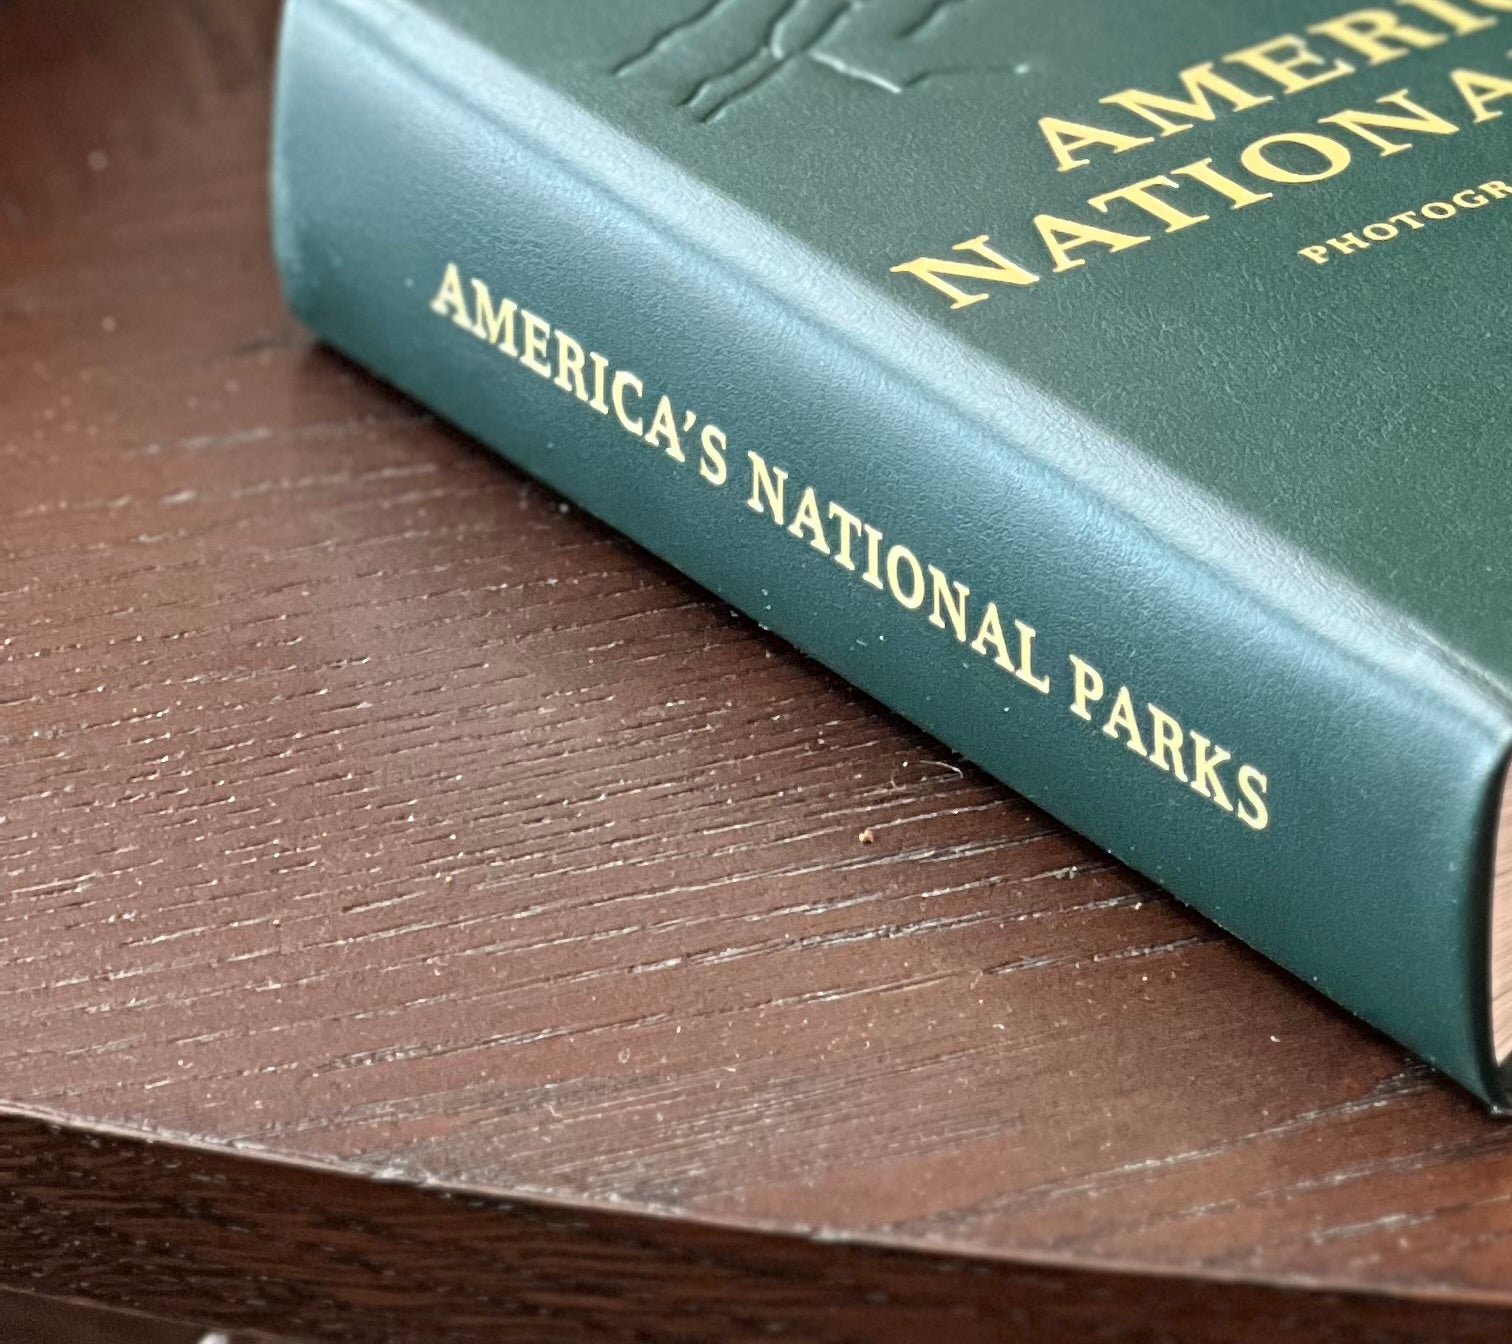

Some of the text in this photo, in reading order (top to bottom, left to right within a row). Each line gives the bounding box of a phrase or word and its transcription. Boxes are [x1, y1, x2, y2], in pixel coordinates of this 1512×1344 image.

[429, 261, 1271, 832] AMERICA'S NATIONAL PARKS
